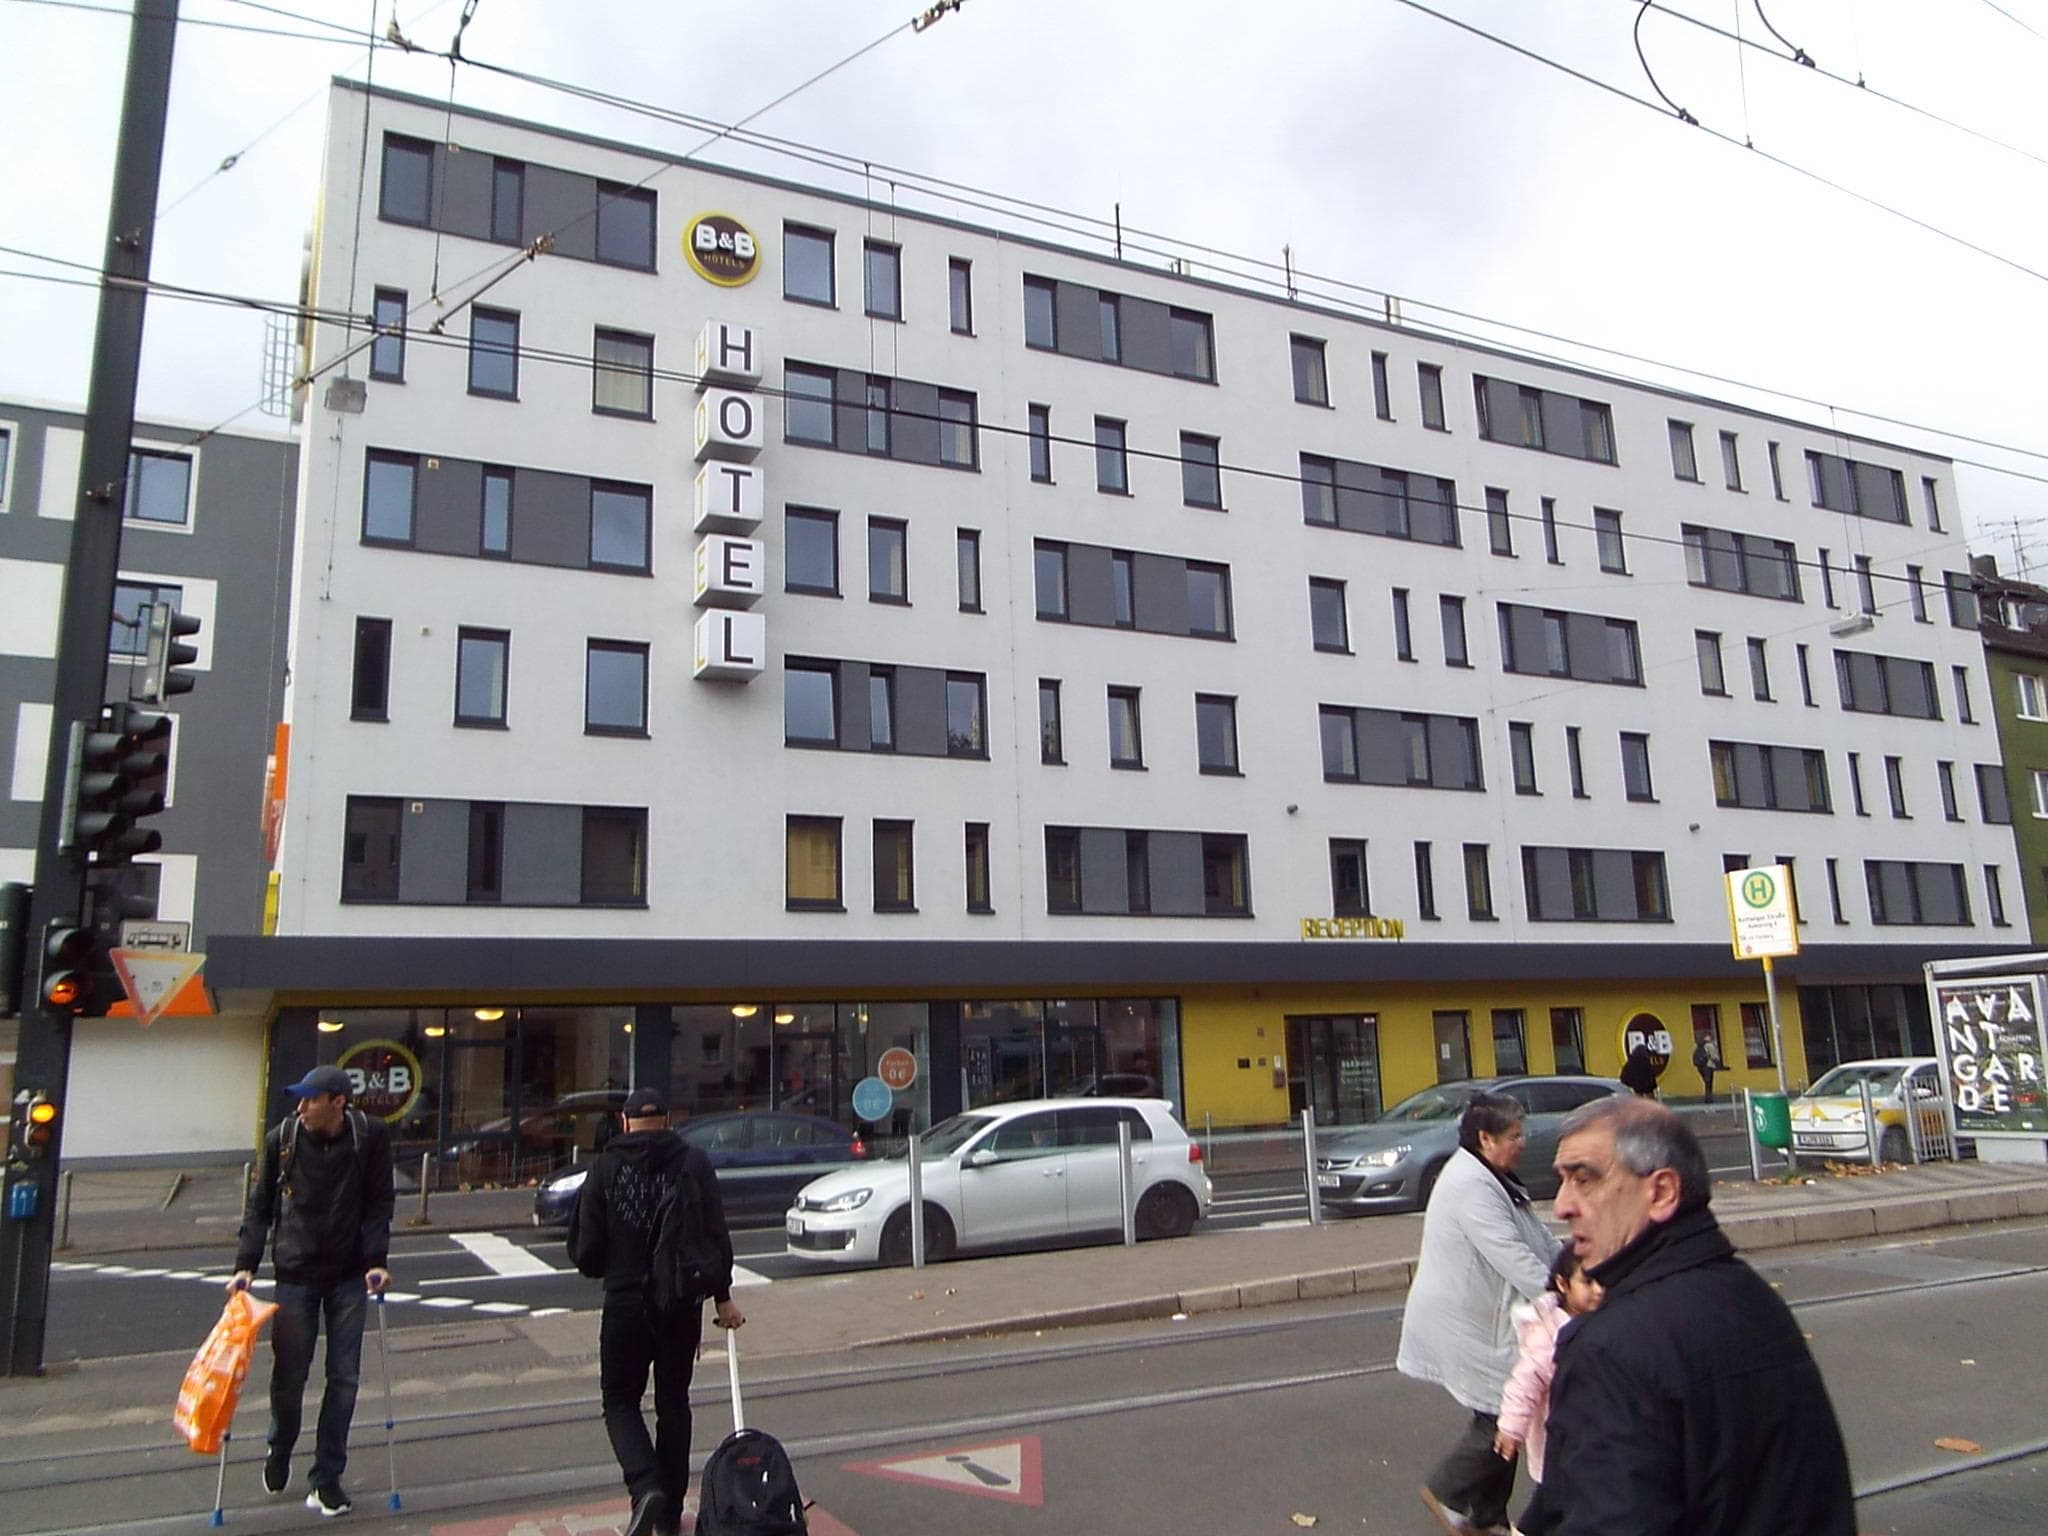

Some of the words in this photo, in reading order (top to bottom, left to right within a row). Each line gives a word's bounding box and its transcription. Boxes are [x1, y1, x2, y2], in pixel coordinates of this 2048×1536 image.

[696, 224, 755, 258] B&B
[703, 253, 746, 269] HOTELS
[720, 324, 754, 665] HOTEL
[1750, 878, 1767, 900] H
[1301, 918, 1404, 939] RECEPTION
[1947, 985, 2033, 1024] AVA
[344, 1066, 412, 1095] B&B
[1953, 1052, 2038, 1083] GAR
[1957, 1083, 2010, 1112] DE
